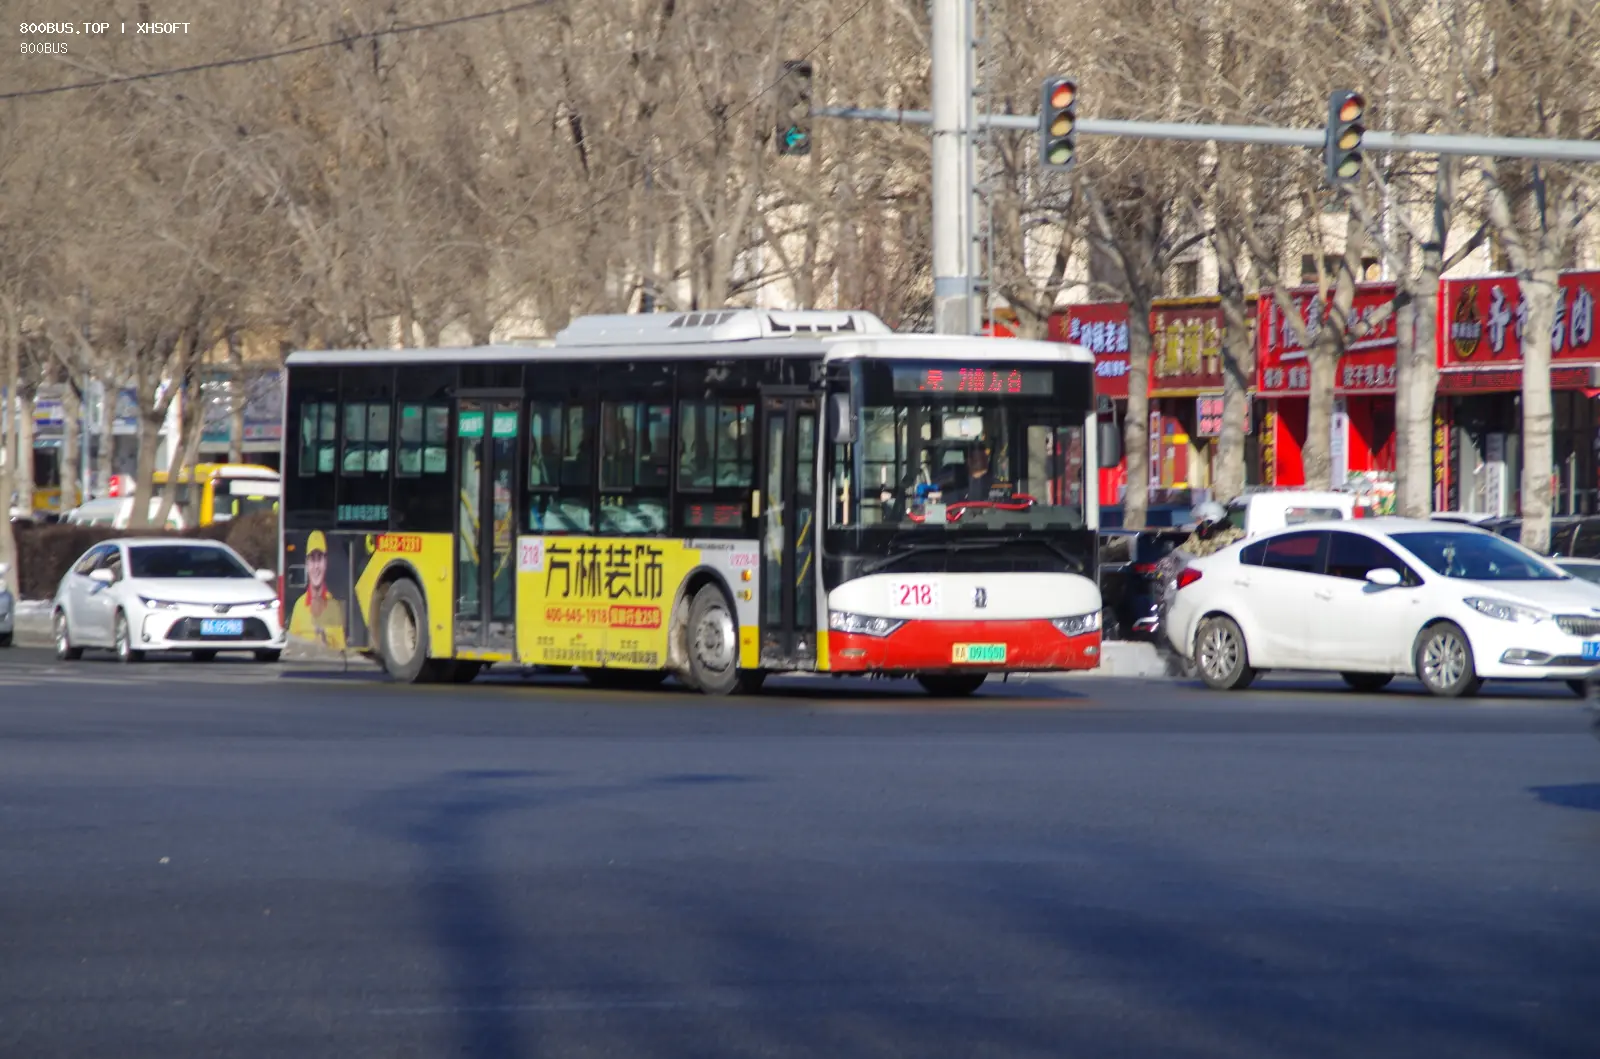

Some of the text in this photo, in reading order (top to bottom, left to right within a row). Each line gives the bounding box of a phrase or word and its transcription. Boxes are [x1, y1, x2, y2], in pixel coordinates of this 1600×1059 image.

[521, 544, 540, 565] 218
[544, 542, 664, 600] 方林装饰
[900, 583, 932, 607] 218
